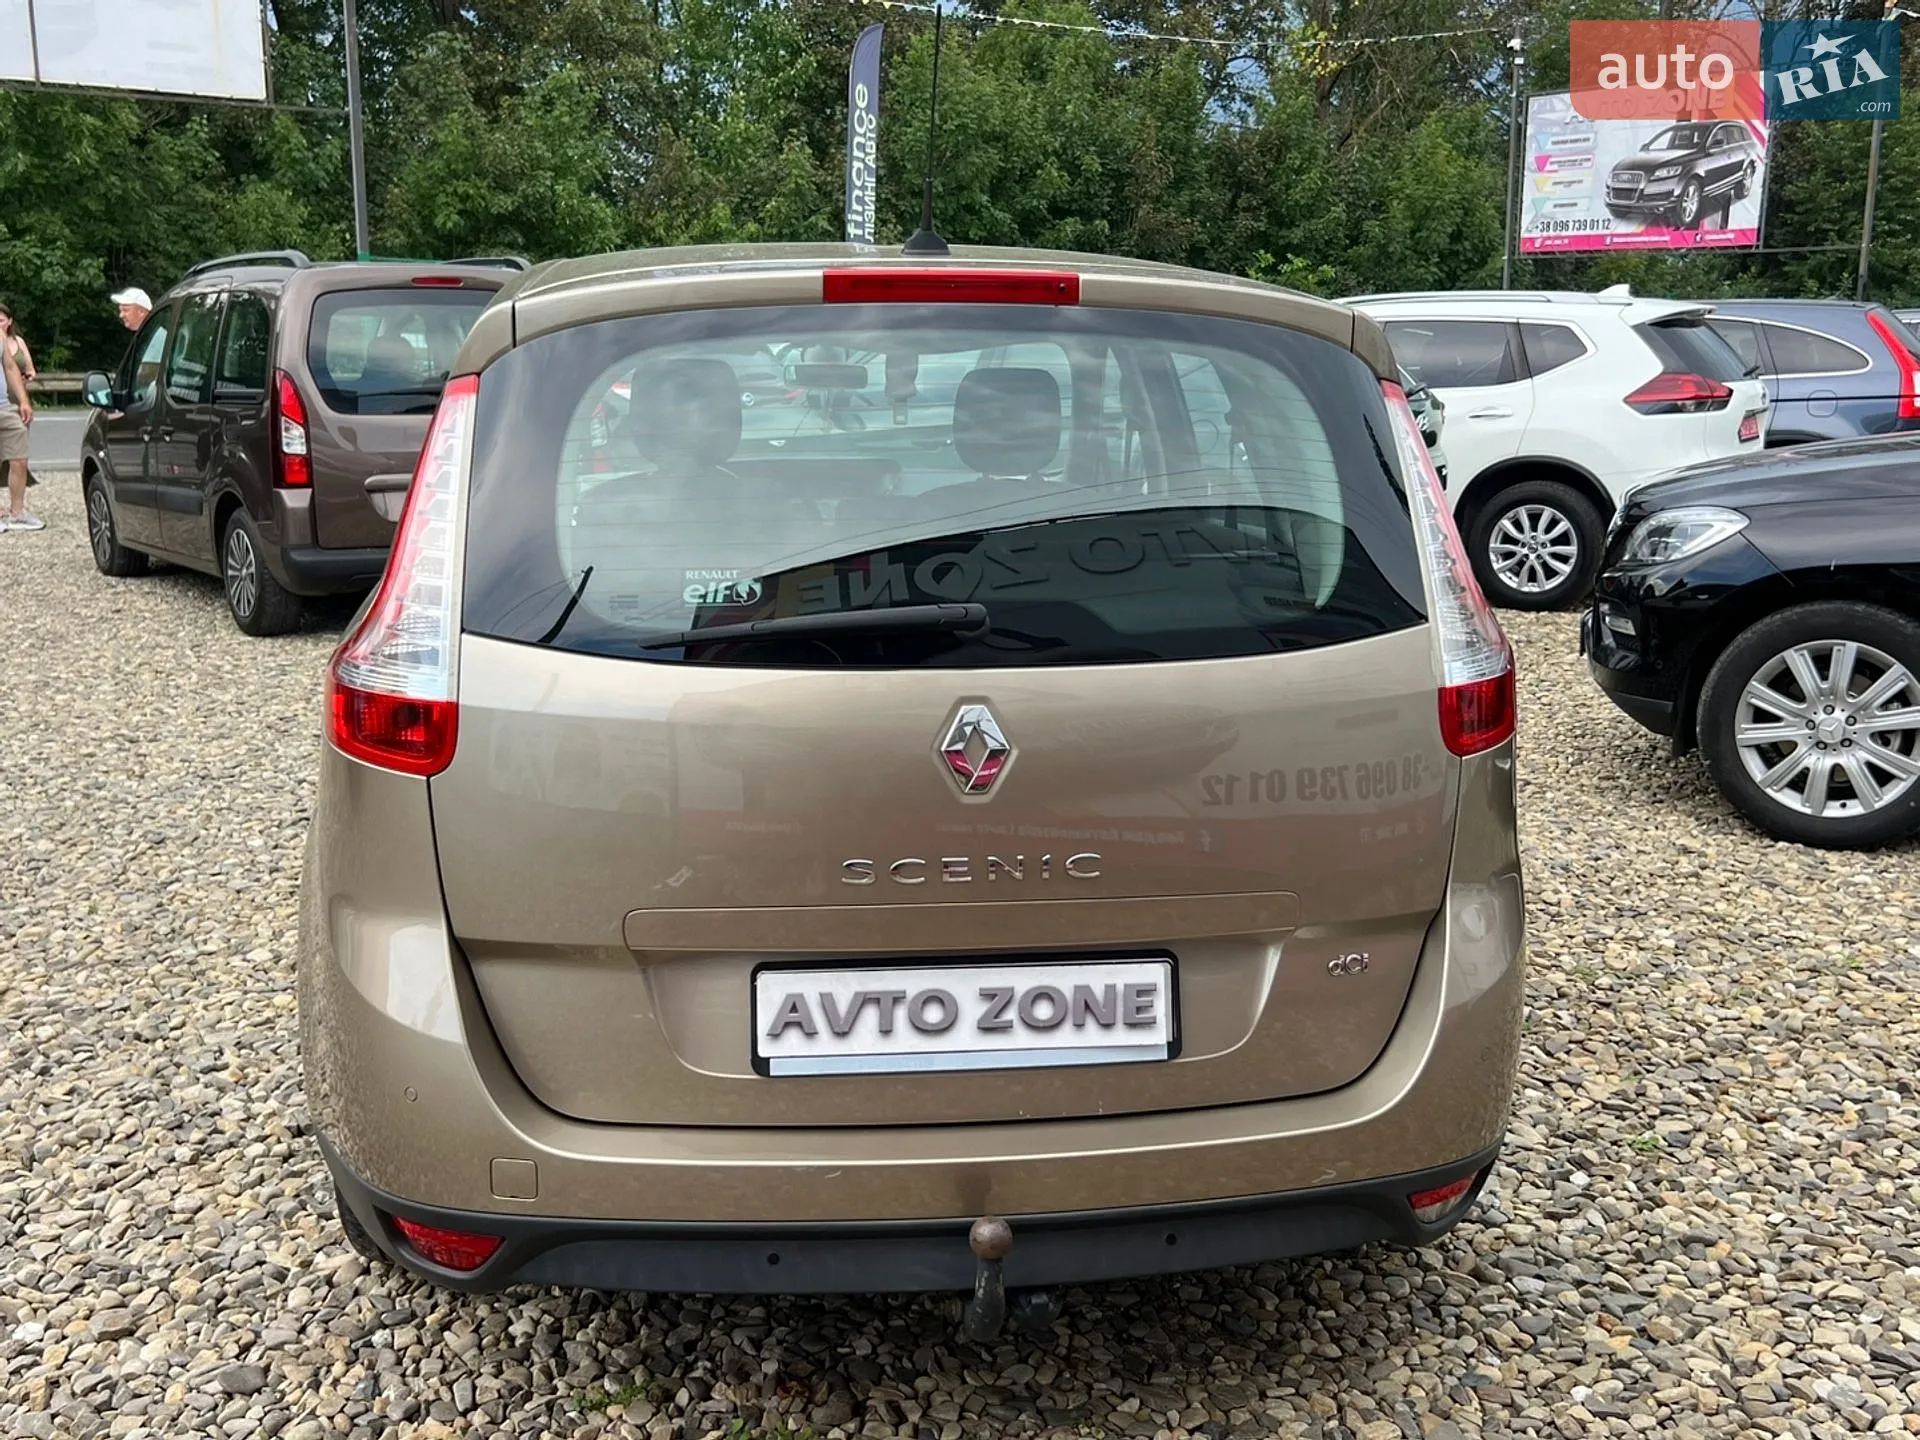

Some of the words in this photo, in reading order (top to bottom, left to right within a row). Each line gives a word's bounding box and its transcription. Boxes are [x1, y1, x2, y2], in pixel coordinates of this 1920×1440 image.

[865, 113, 877, 168] АВТО
[846, 83, 868, 238] finance
[1553, 220, 1570, 233] 096
[1572, 219, 1588, 232] 739
[1590, 218, 1601, 231] 01
[1602, 217, 1611, 230] 12
[686, 569, 739, 580] RENAULT
[1327, 953, 1369, 976] dCi
[766, 989, 959, 1038] AVTO
[977, 982, 1158, 1031] ZONE
